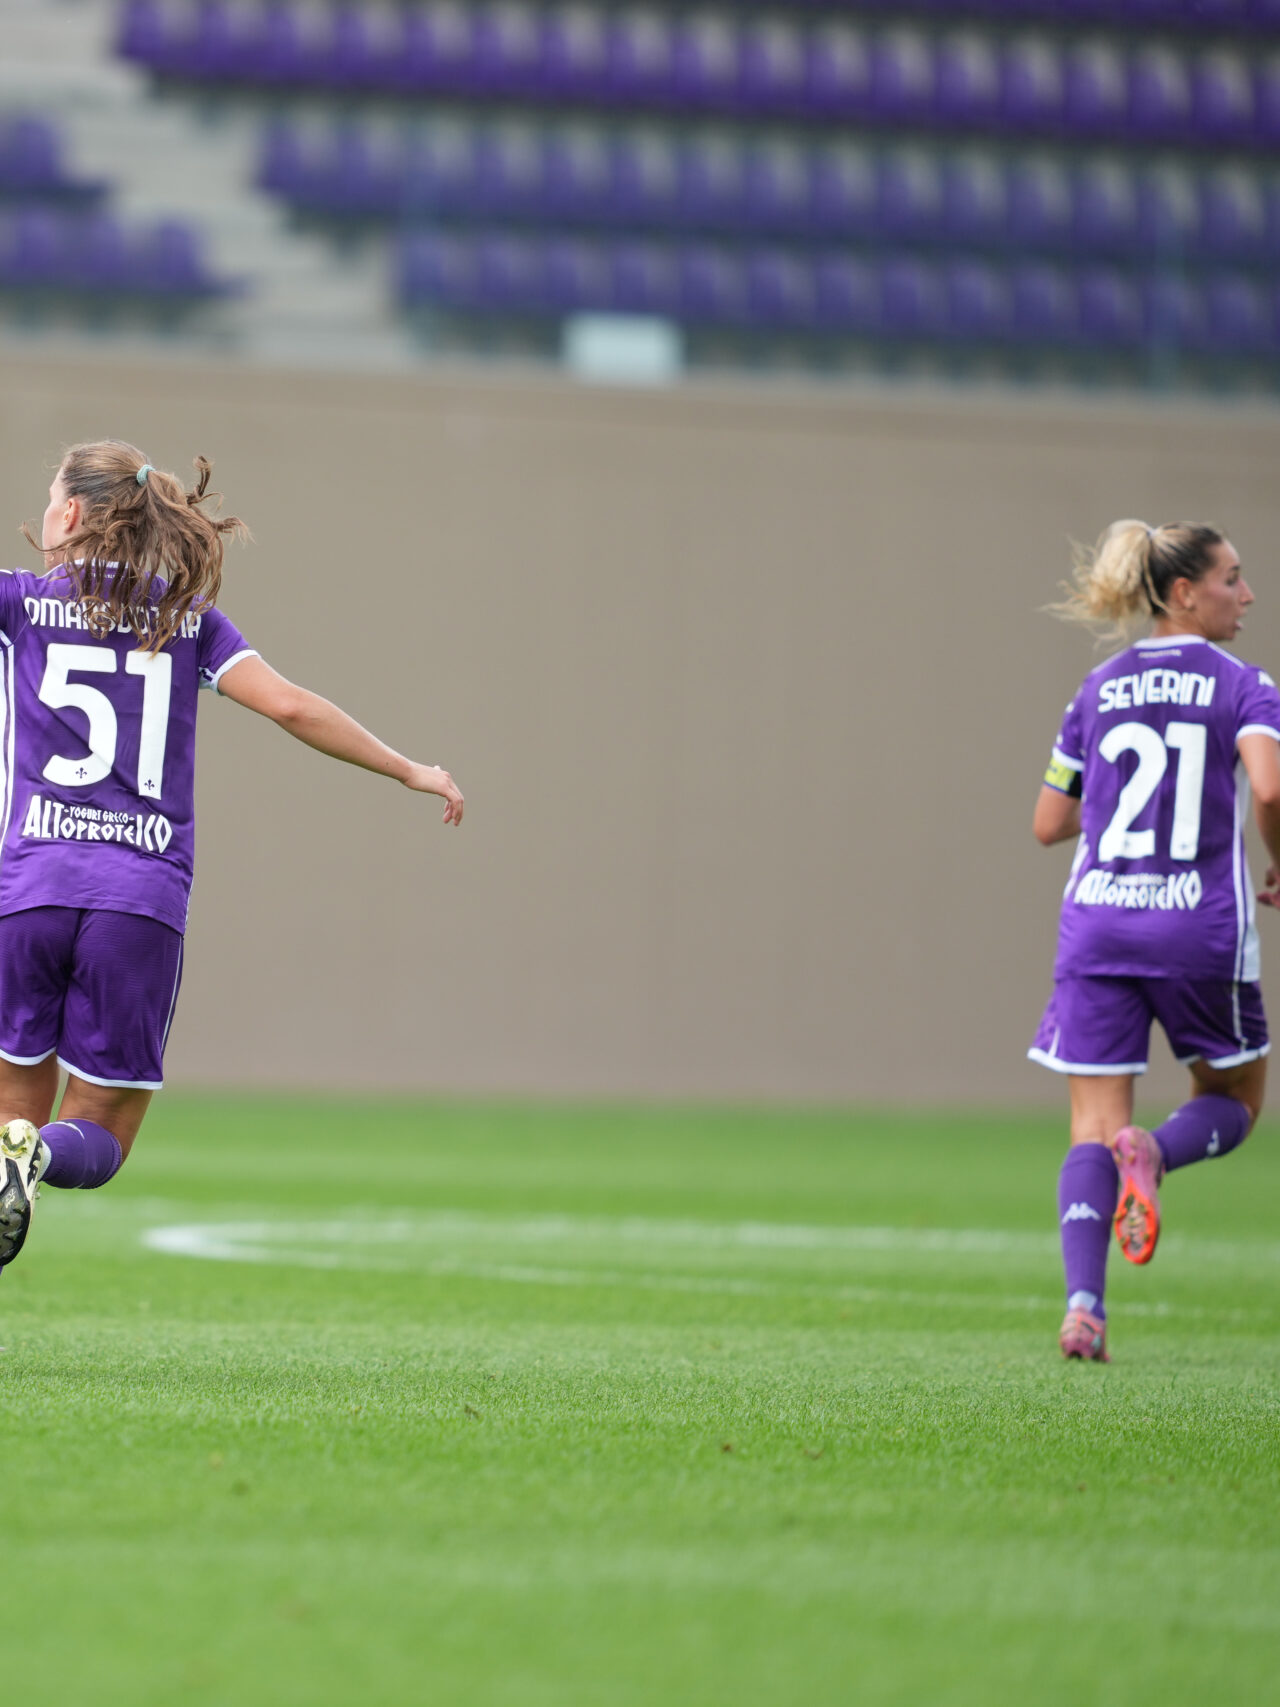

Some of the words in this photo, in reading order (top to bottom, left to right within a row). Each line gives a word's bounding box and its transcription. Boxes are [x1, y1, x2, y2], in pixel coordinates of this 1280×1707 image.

[38, 642, 173, 800] 51
[1098, 668, 1216, 713] SEVERINI
[1098, 721, 1207, 862] 21
